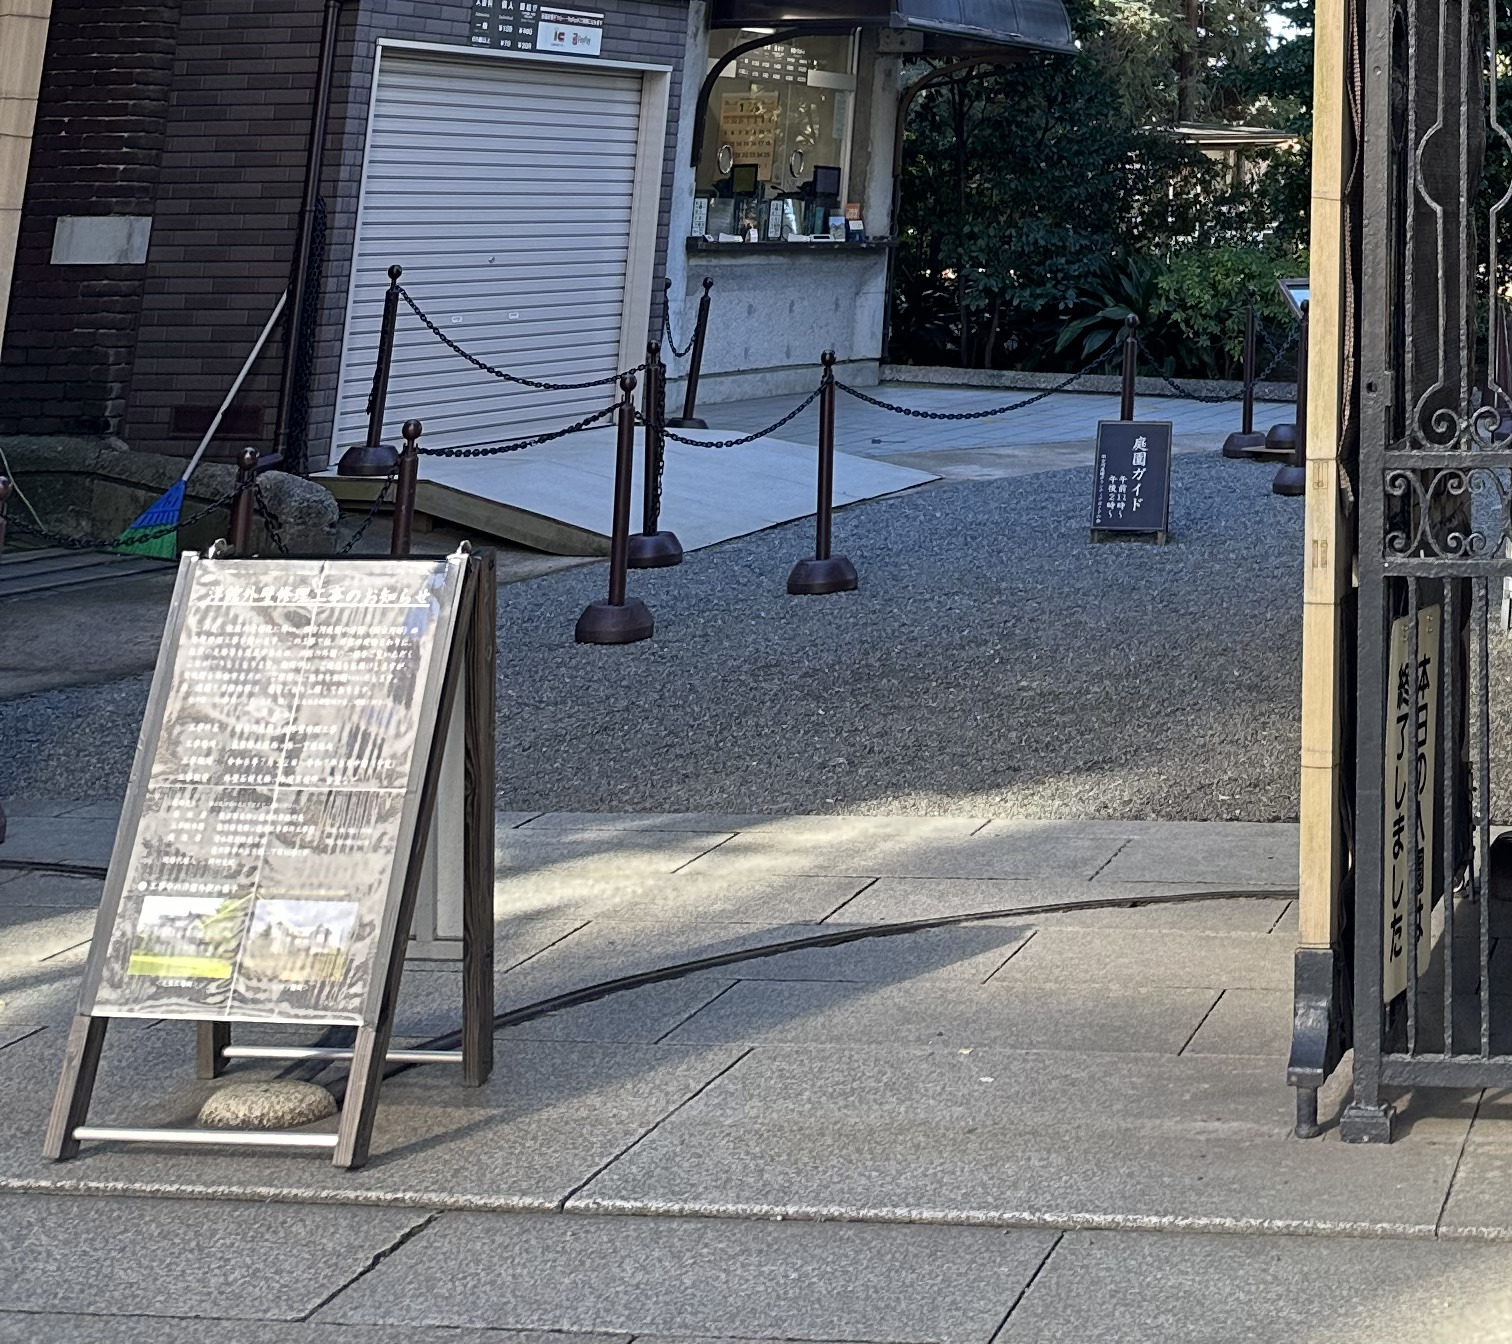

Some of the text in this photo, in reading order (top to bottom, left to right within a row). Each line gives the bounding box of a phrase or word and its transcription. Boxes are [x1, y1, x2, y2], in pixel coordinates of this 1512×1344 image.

[1132, 436, 1149, 512] 庭園ガイド
